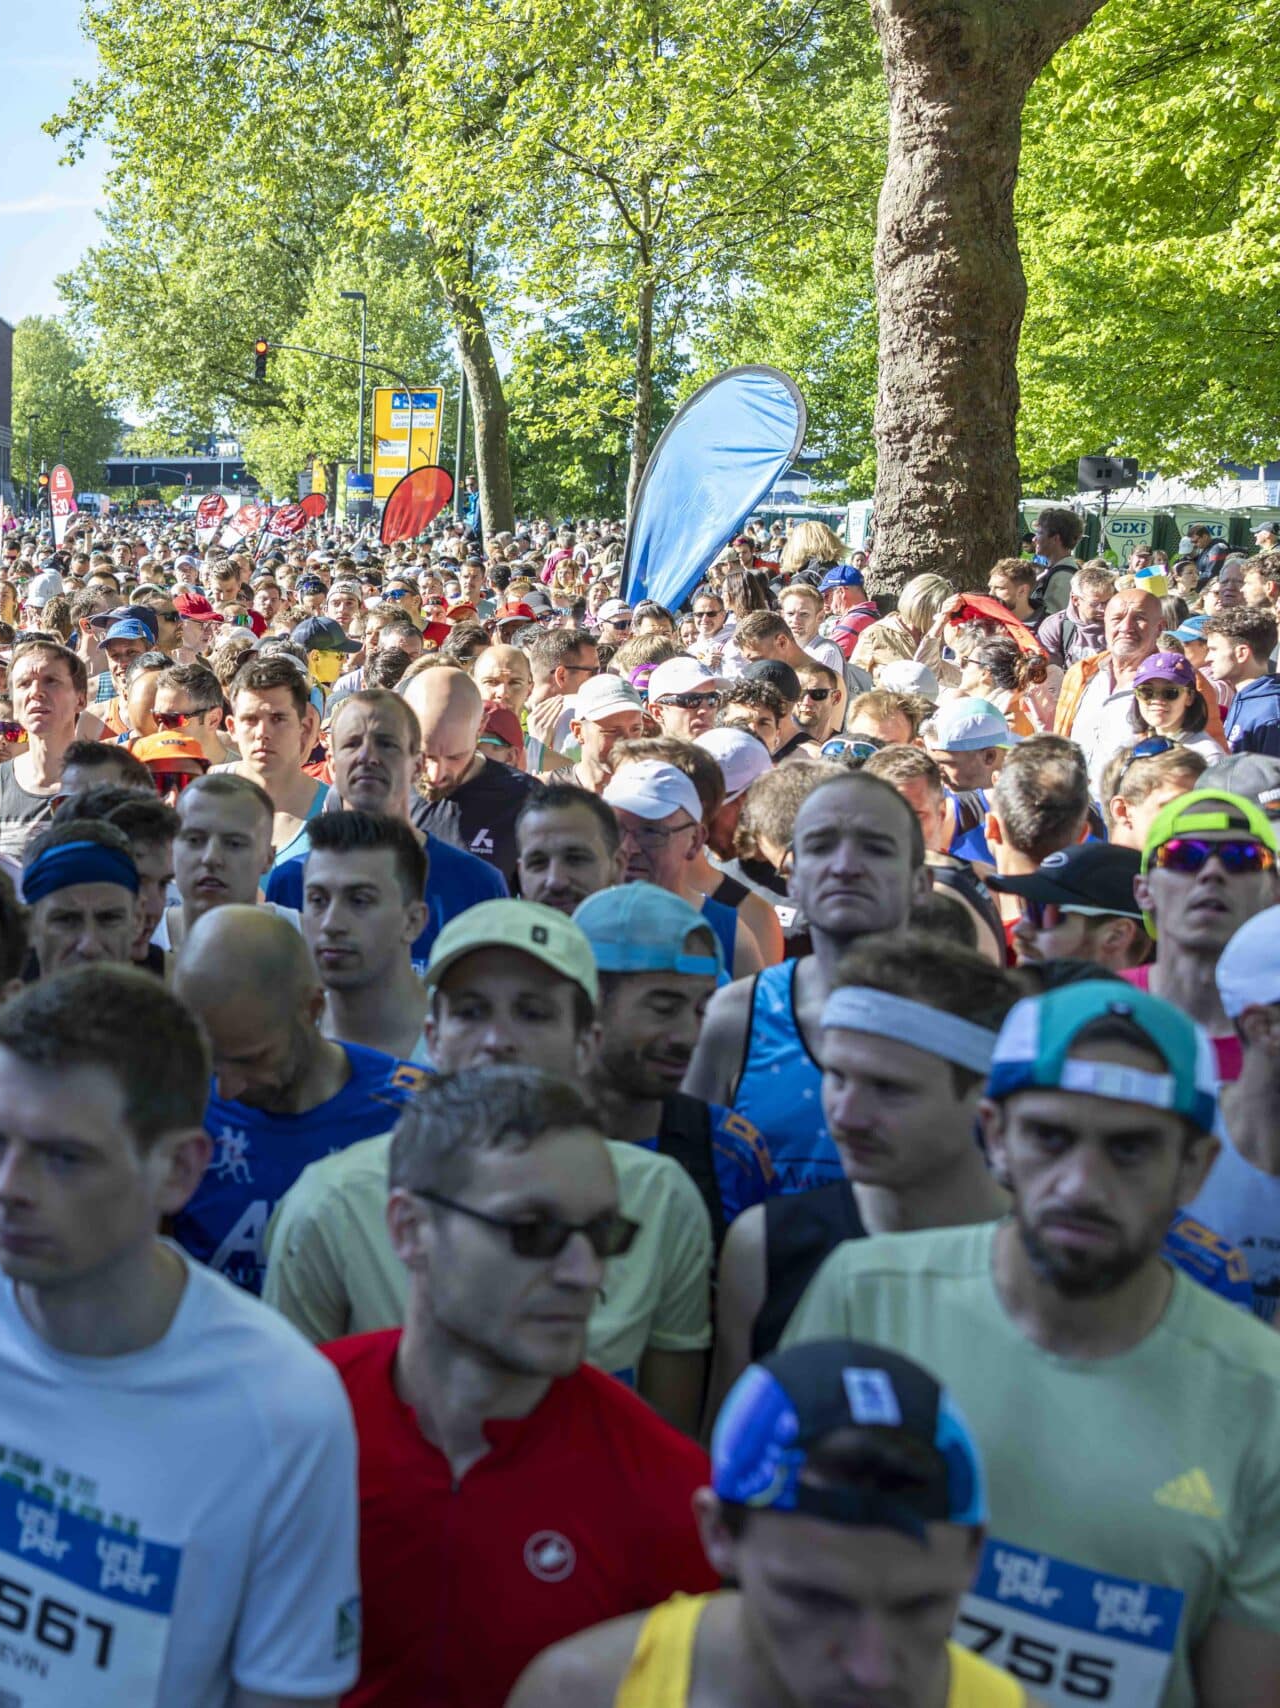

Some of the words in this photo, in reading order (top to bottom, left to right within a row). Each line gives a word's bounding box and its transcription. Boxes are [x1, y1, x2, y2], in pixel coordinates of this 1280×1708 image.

[198, 515, 219, 528] 3:45
[1111, 522, 1147, 534] DIXI
[209, 1200, 272, 1268] A
[16, 1500, 60, 1536] uni
[19, 1530, 70, 1562] per
[96, 1535, 146, 1573] uni
[993, 1548, 1050, 1579] uni
[100, 1567, 160, 1598] per
[996, 1577, 1063, 1609] per
[1092, 1580, 1150, 1611] uni
[1096, 1606, 1163, 1637] per
